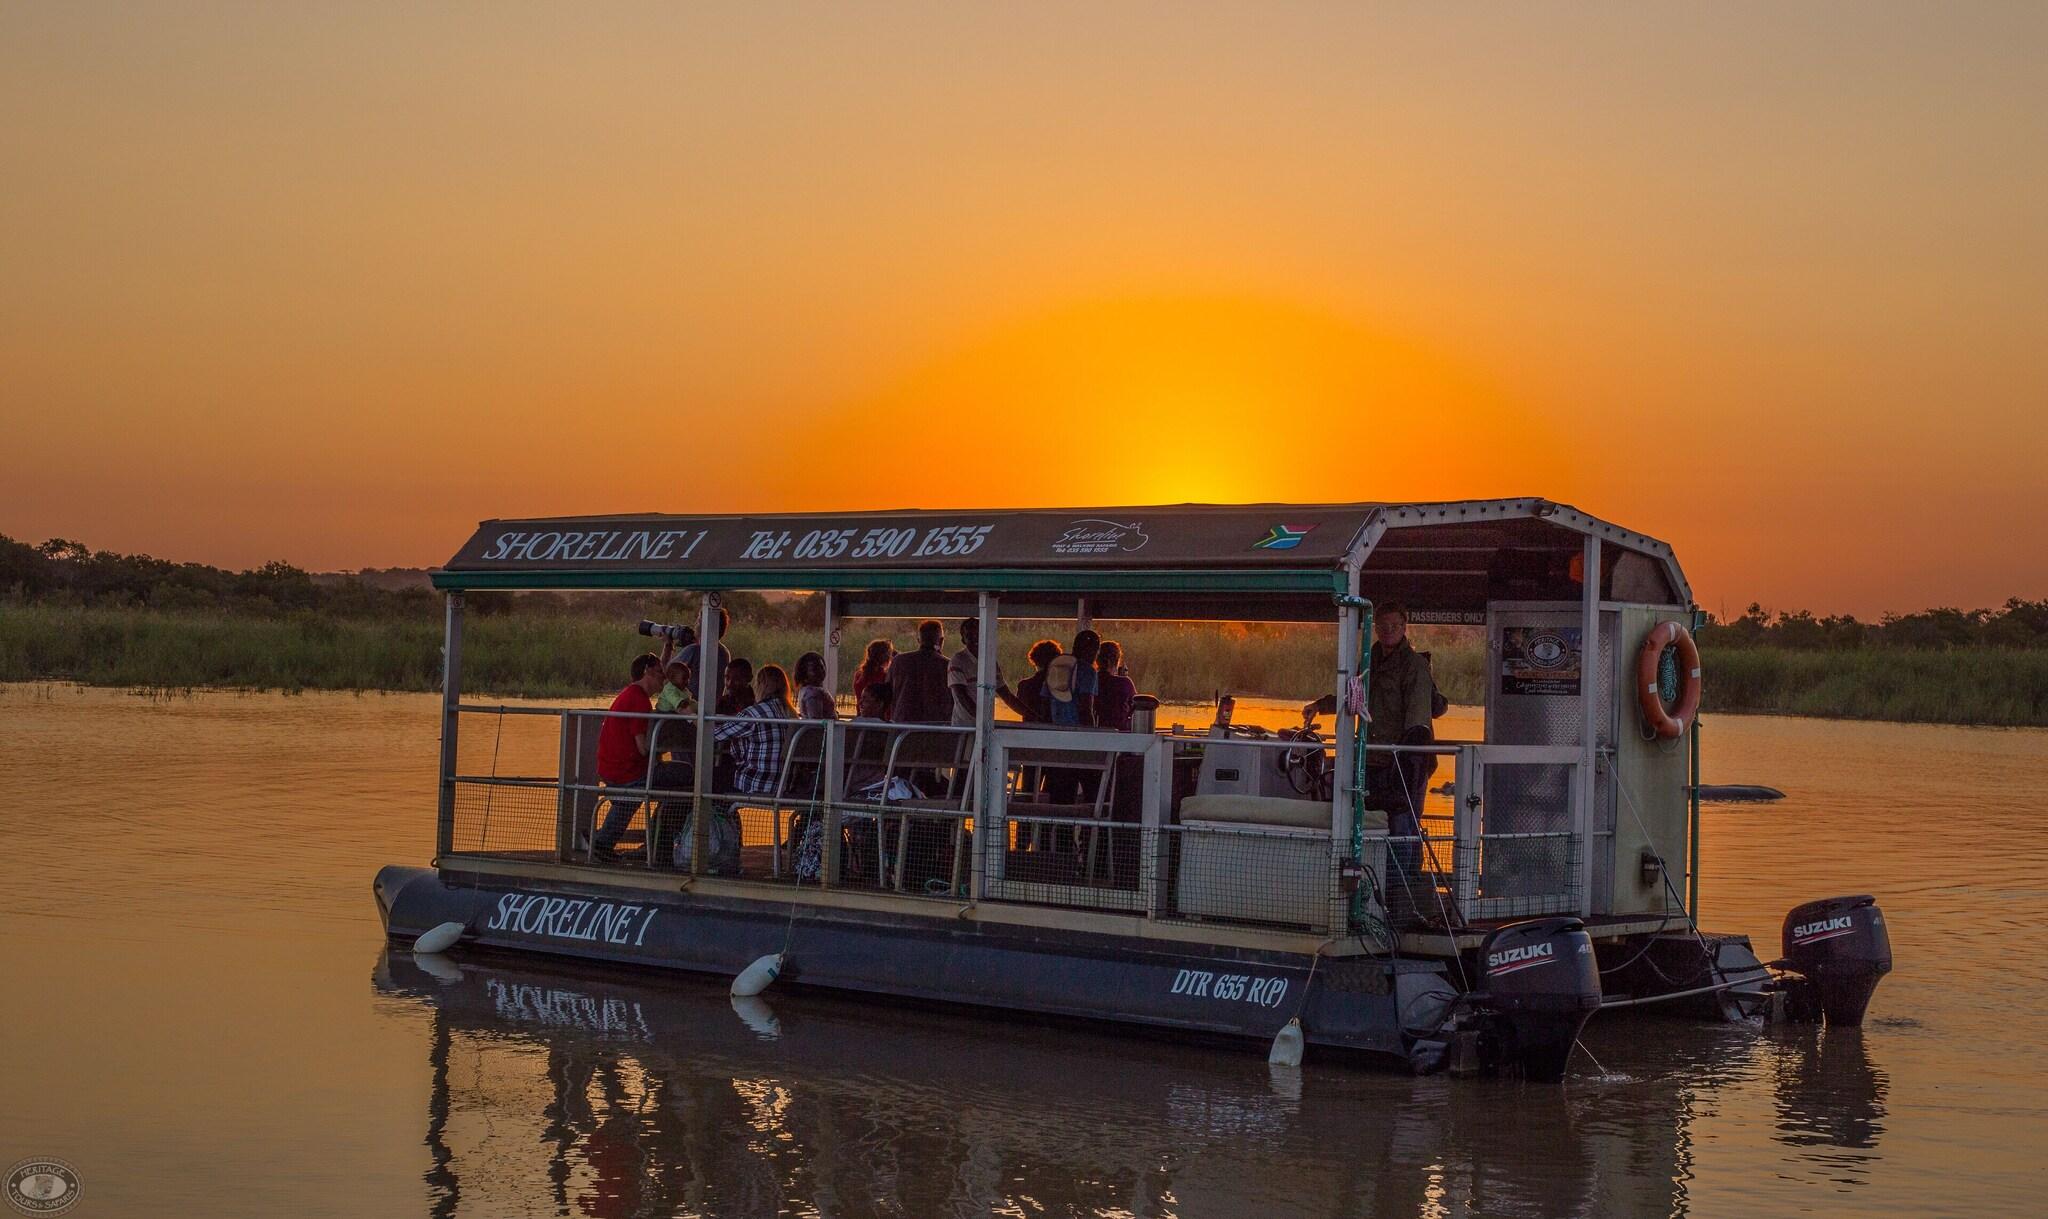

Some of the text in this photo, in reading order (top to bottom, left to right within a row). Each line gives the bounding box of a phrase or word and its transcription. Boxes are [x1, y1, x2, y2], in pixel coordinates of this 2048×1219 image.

[482, 529, 708, 560] SHORELINE 1
[739, 524, 994, 559] Tel: 035 590 1555
[1411, 611, 1462, 623] PASSENGERS
[1463, 612, 1485, 624] ONLY
[487, 893, 658, 946] SHORELINE 1
[1793, 916, 1852, 938] SUZUKI
[1488, 942, 1552, 967] SUZUKI
[1171, 969, 1288, 1008] DTR 655 R(P)
